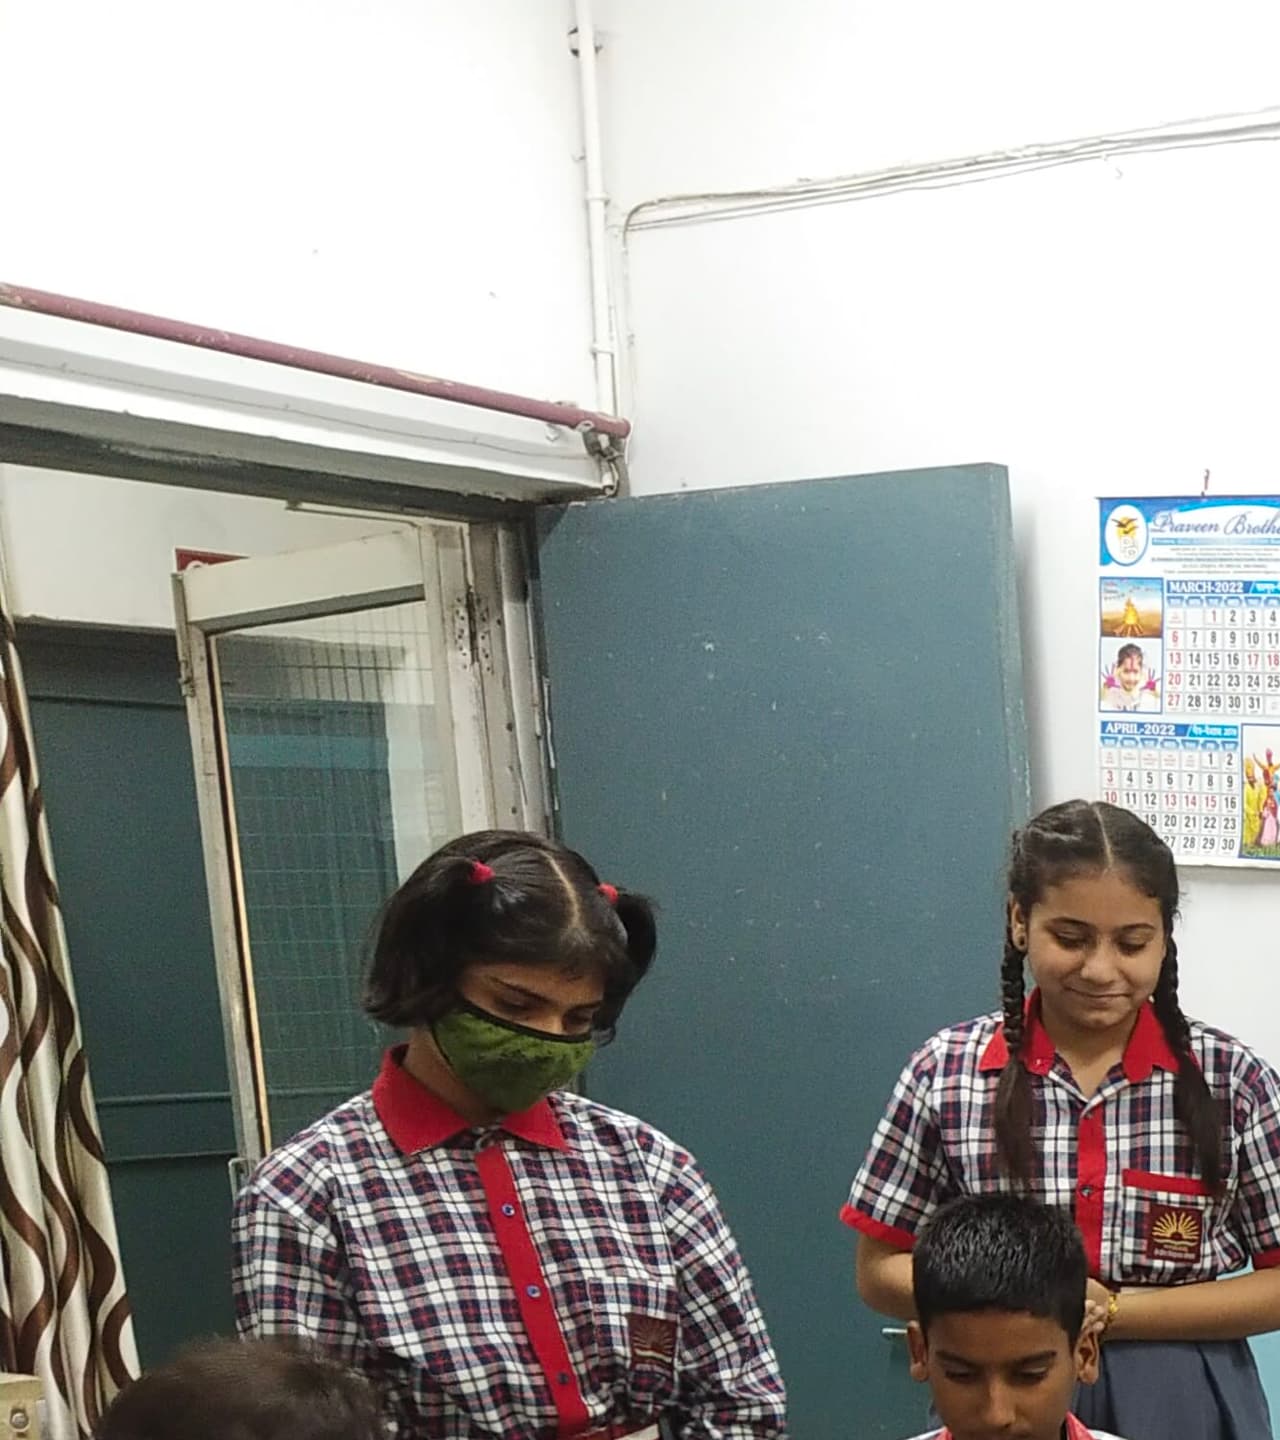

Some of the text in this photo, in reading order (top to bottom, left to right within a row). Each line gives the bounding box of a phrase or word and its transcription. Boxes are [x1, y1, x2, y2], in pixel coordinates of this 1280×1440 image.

[1150, 511, 1220, 533] Praveen
[1169, 581, 1244, 594] MARCH-2022
[1212, 610, 1217, 623] 1
[1230, 610, 1236, 622] 2
[1250, 610, 1256, 623] 3
[1270, 610, 1277, 622] 4
[1172, 631, 1179, 643] 6
[1191, 631, 1198, 644] 7
[1210, 631, 1217, 644] 8
[1230, 631, 1236, 644] 9
[1247, 632, 1260, 645] 10
[1267, 632, 1279, 645] 11
[1169, 652, 1182, 664] 13
[1189, 653, 1201, 665] 14
[1208, 653, 1220, 665] 15
[1227, 653, 1240, 665] 16
[1248, 653, 1259, 666] 17
[1267, 654, 1280, 667] 18
[1168, 673, 1181, 685] 20
[1188, 674, 1201, 686] 21
[1207, 674, 1221, 686] 22
[1227, 674, 1240, 687] 23
[1247, 675, 1260, 688] 24
[1267, 675, 1280, 688] 25
[1167, 694, 1260, 709] 27 28 29 30 31
[1105, 722, 1176, 736] APRIL-2022
[1208, 753, 1233, 766] 1 2
[1107, 770, 1233, 788] 3 4 5 6 7 8 9
[1126, 792, 1137, 804] 11
[1144, 793, 1157, 805] 12
[1164, 794, 1177, 806] 13
[1184, 795, 1196, 807] 14
[1205, 796, 1217, 808] 15
[1224, 797, 1236, 809] 16
[1164, 814, 1177, 827] 20
[1184, 816, 1196, 828] 21
[1204, 817, 1216, 829] 22
[1224, 818, 1236, 830] 23
[1183, 836, 1196, 849] 28
[1202, 837, 1215, 850] 29
[1222, 838, 1235, 850] 30
